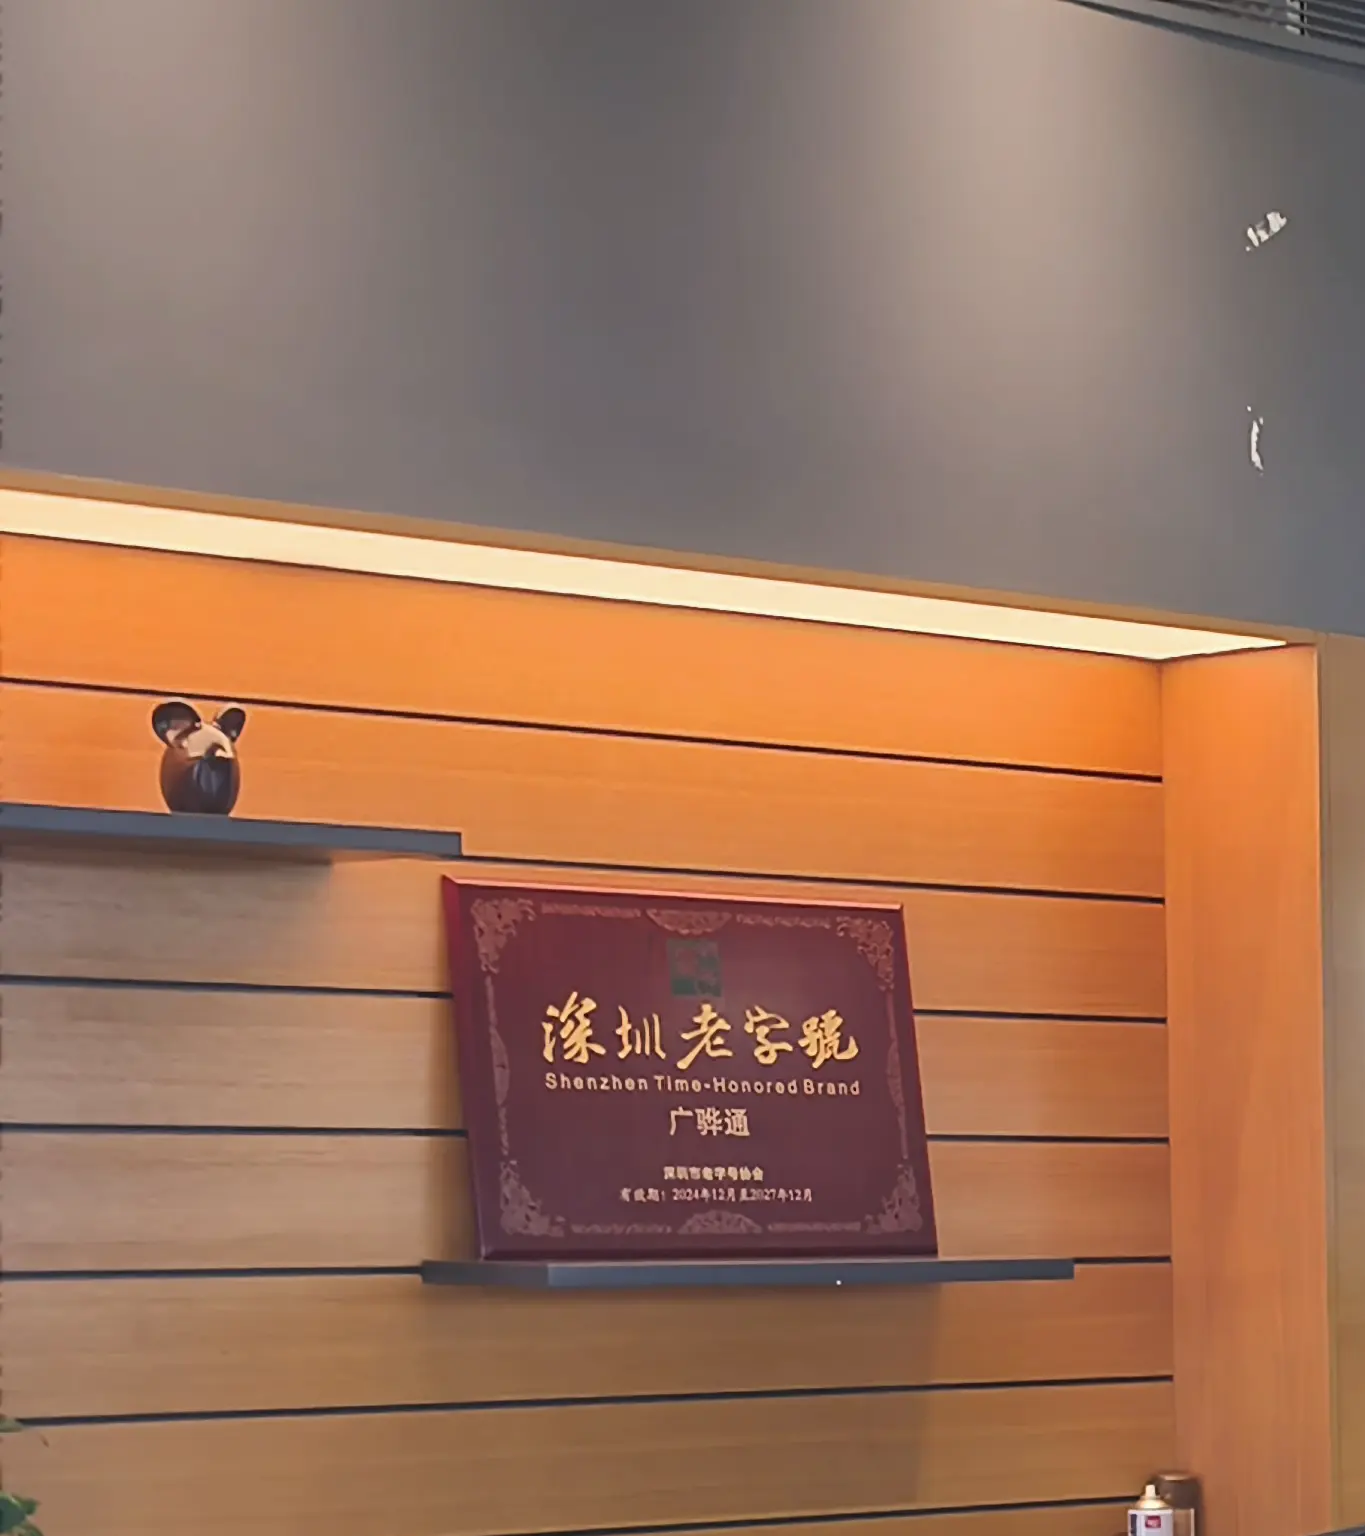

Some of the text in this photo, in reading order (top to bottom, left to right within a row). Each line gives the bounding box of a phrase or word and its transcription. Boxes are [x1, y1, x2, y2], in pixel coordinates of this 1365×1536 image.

[545, 1072, 861, 1097] Shenzhen Time-Honored Brand
[669, 1106, 751, 1137] 广骅通
